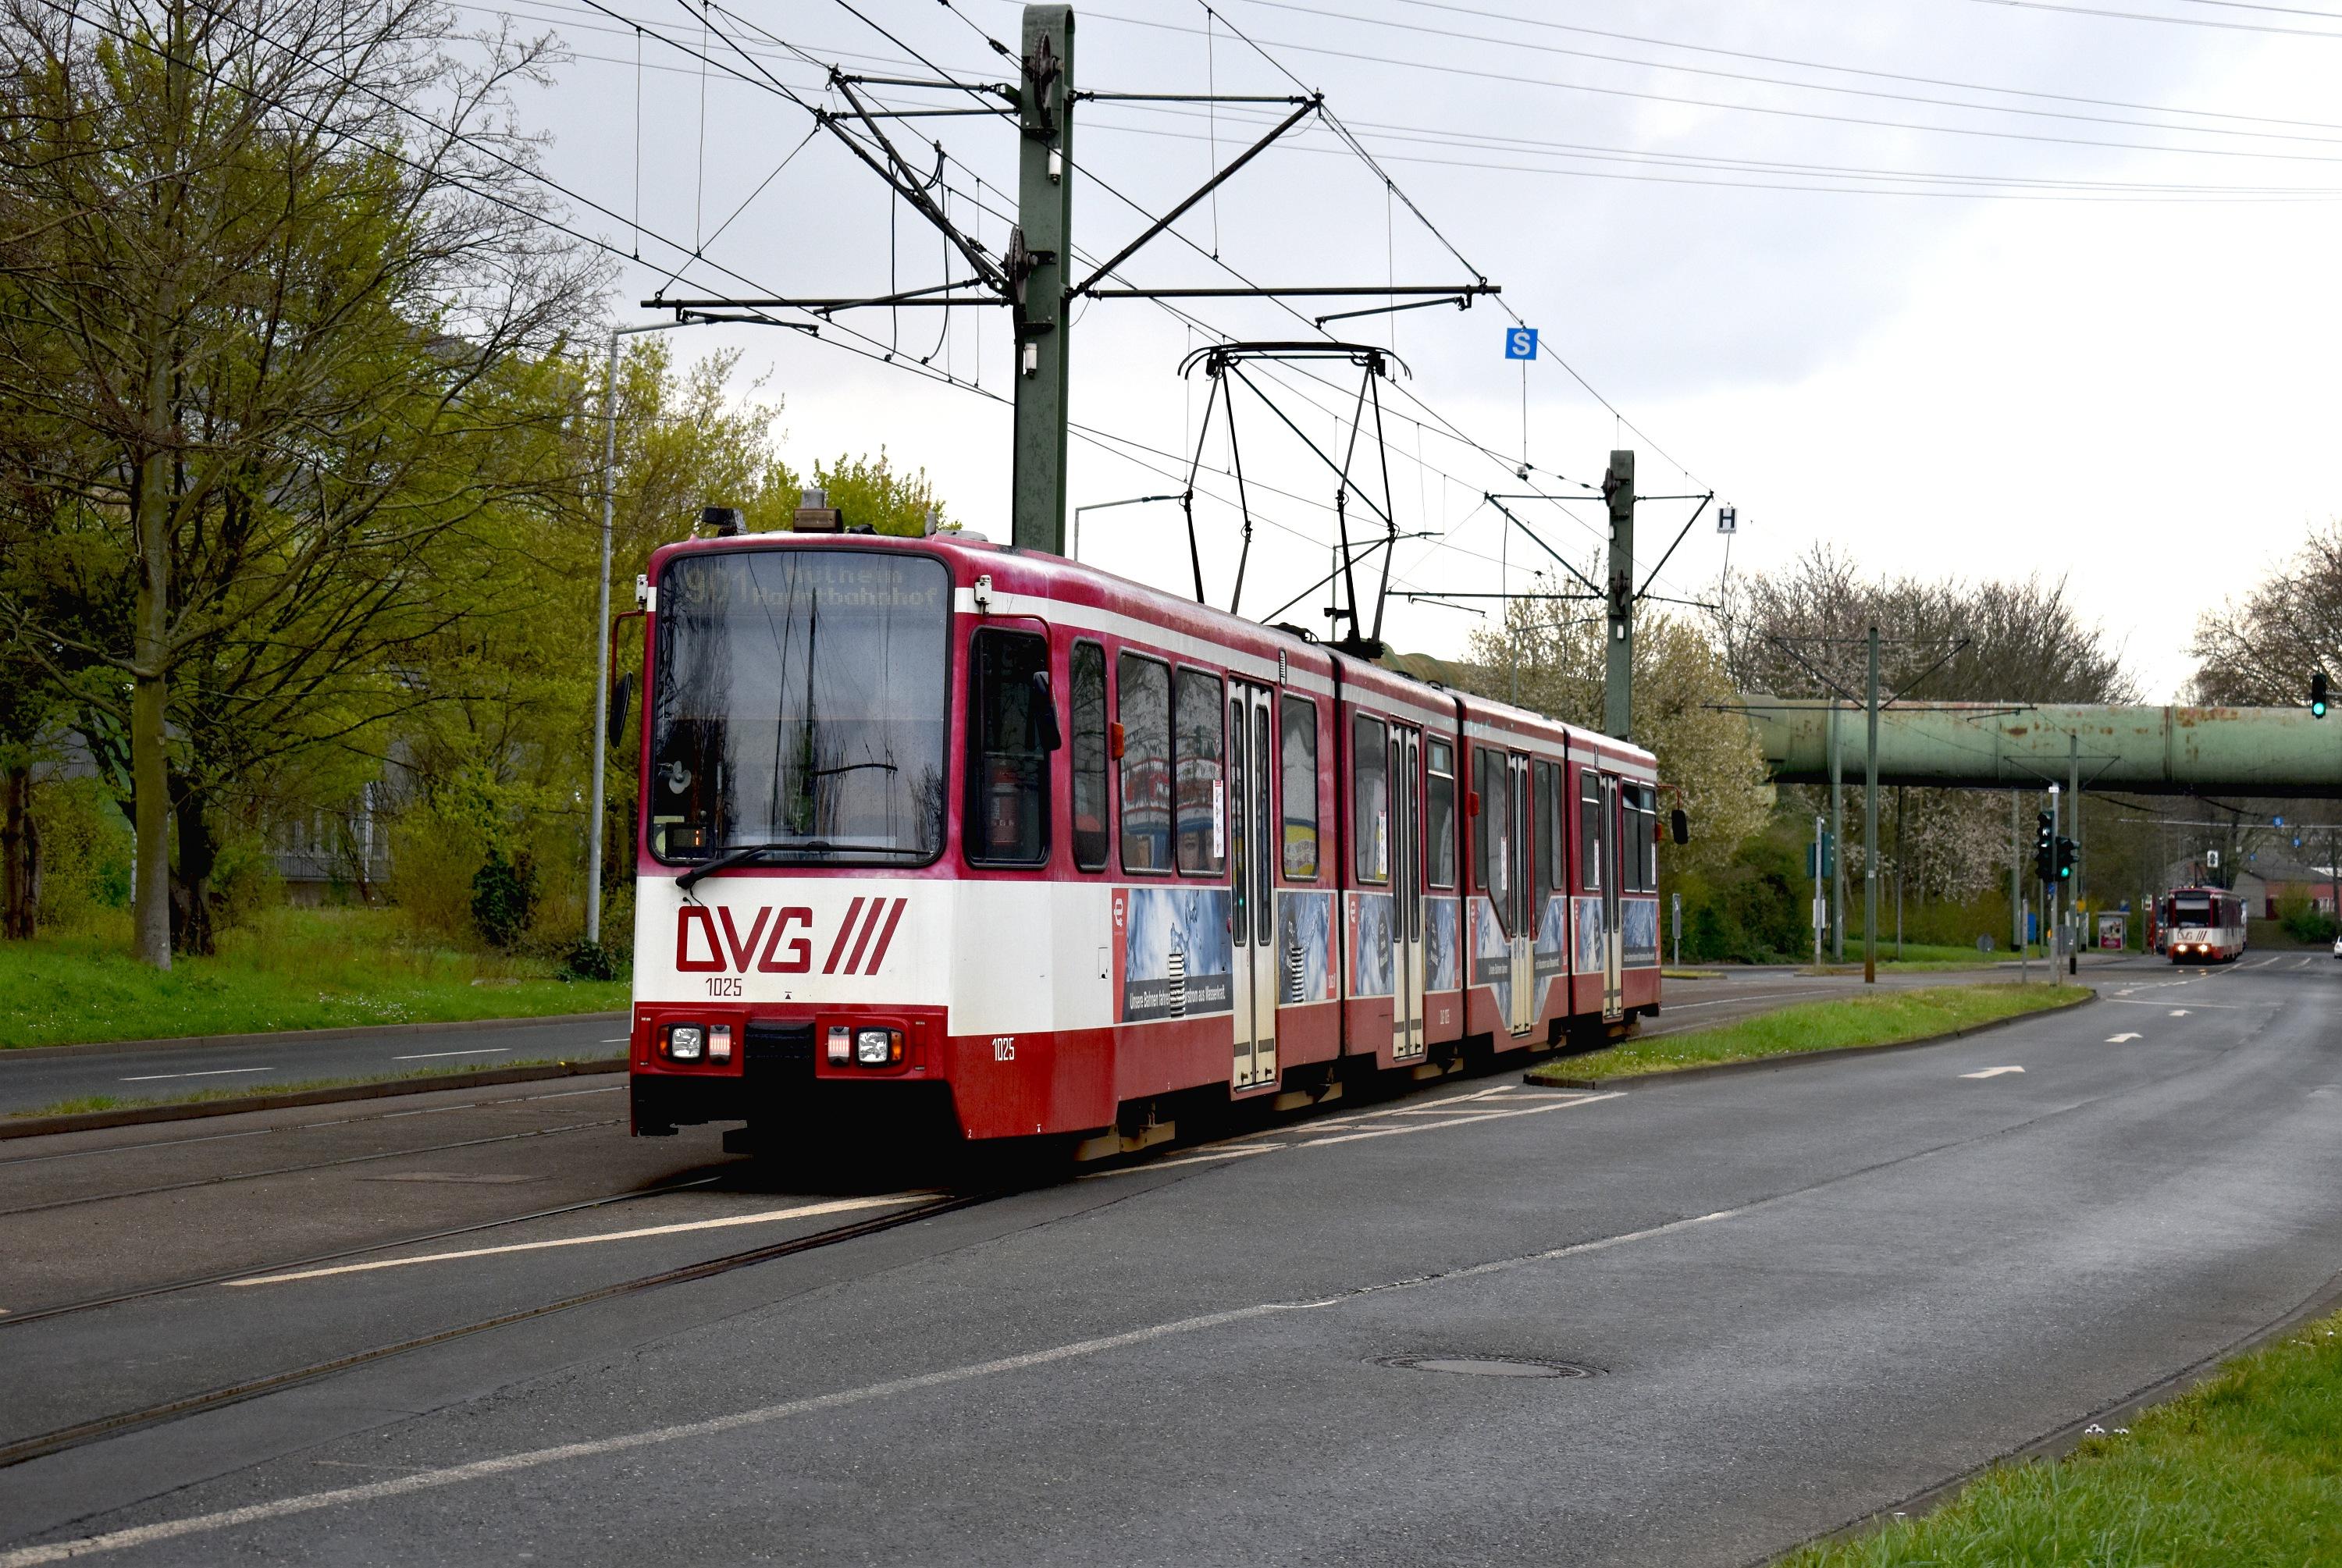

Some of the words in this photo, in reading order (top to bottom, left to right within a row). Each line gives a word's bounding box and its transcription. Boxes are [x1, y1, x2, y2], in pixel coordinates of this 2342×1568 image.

[1512, 332, 1530, 356] S
[1719, 508, 1735, 528] H
[676, 905, 813, 974] DVG
[705, 977, 742, 997] 1025
[991, 1036, 1016, 1061] 1025
